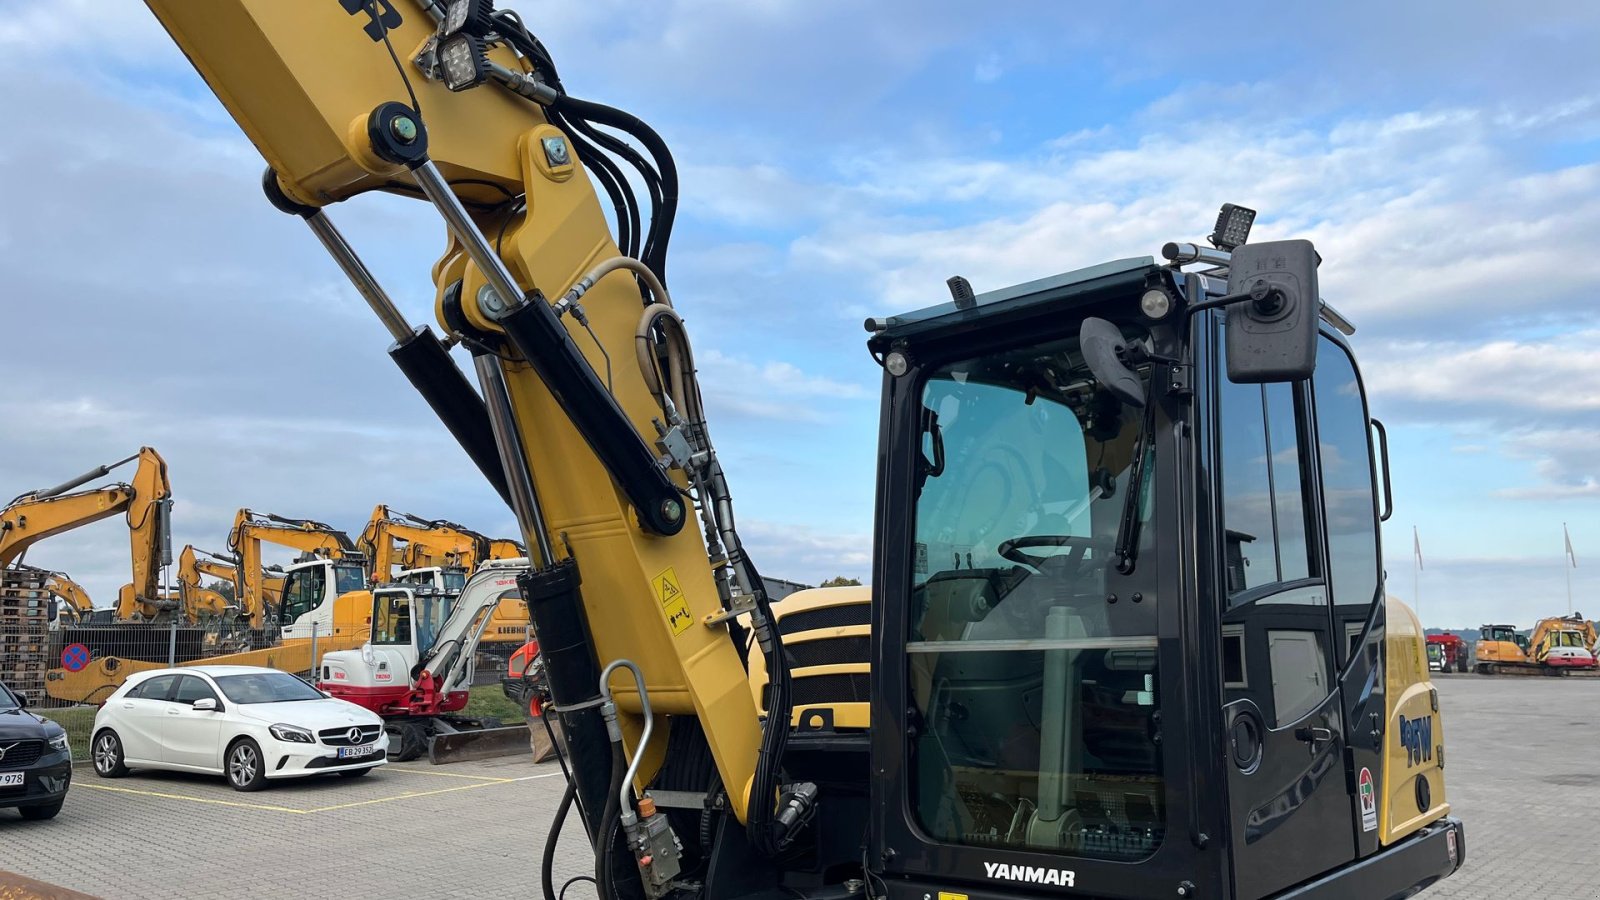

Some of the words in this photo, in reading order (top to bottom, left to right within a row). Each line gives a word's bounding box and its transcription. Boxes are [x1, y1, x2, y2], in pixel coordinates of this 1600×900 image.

[344, 748, 353, 756] EB
[354, 747, 361, 755] 29
[362, 746, 372, 754] 352
[5, 774, 23, 784] 978
[983, 862, 1075, 887] YANMAR
